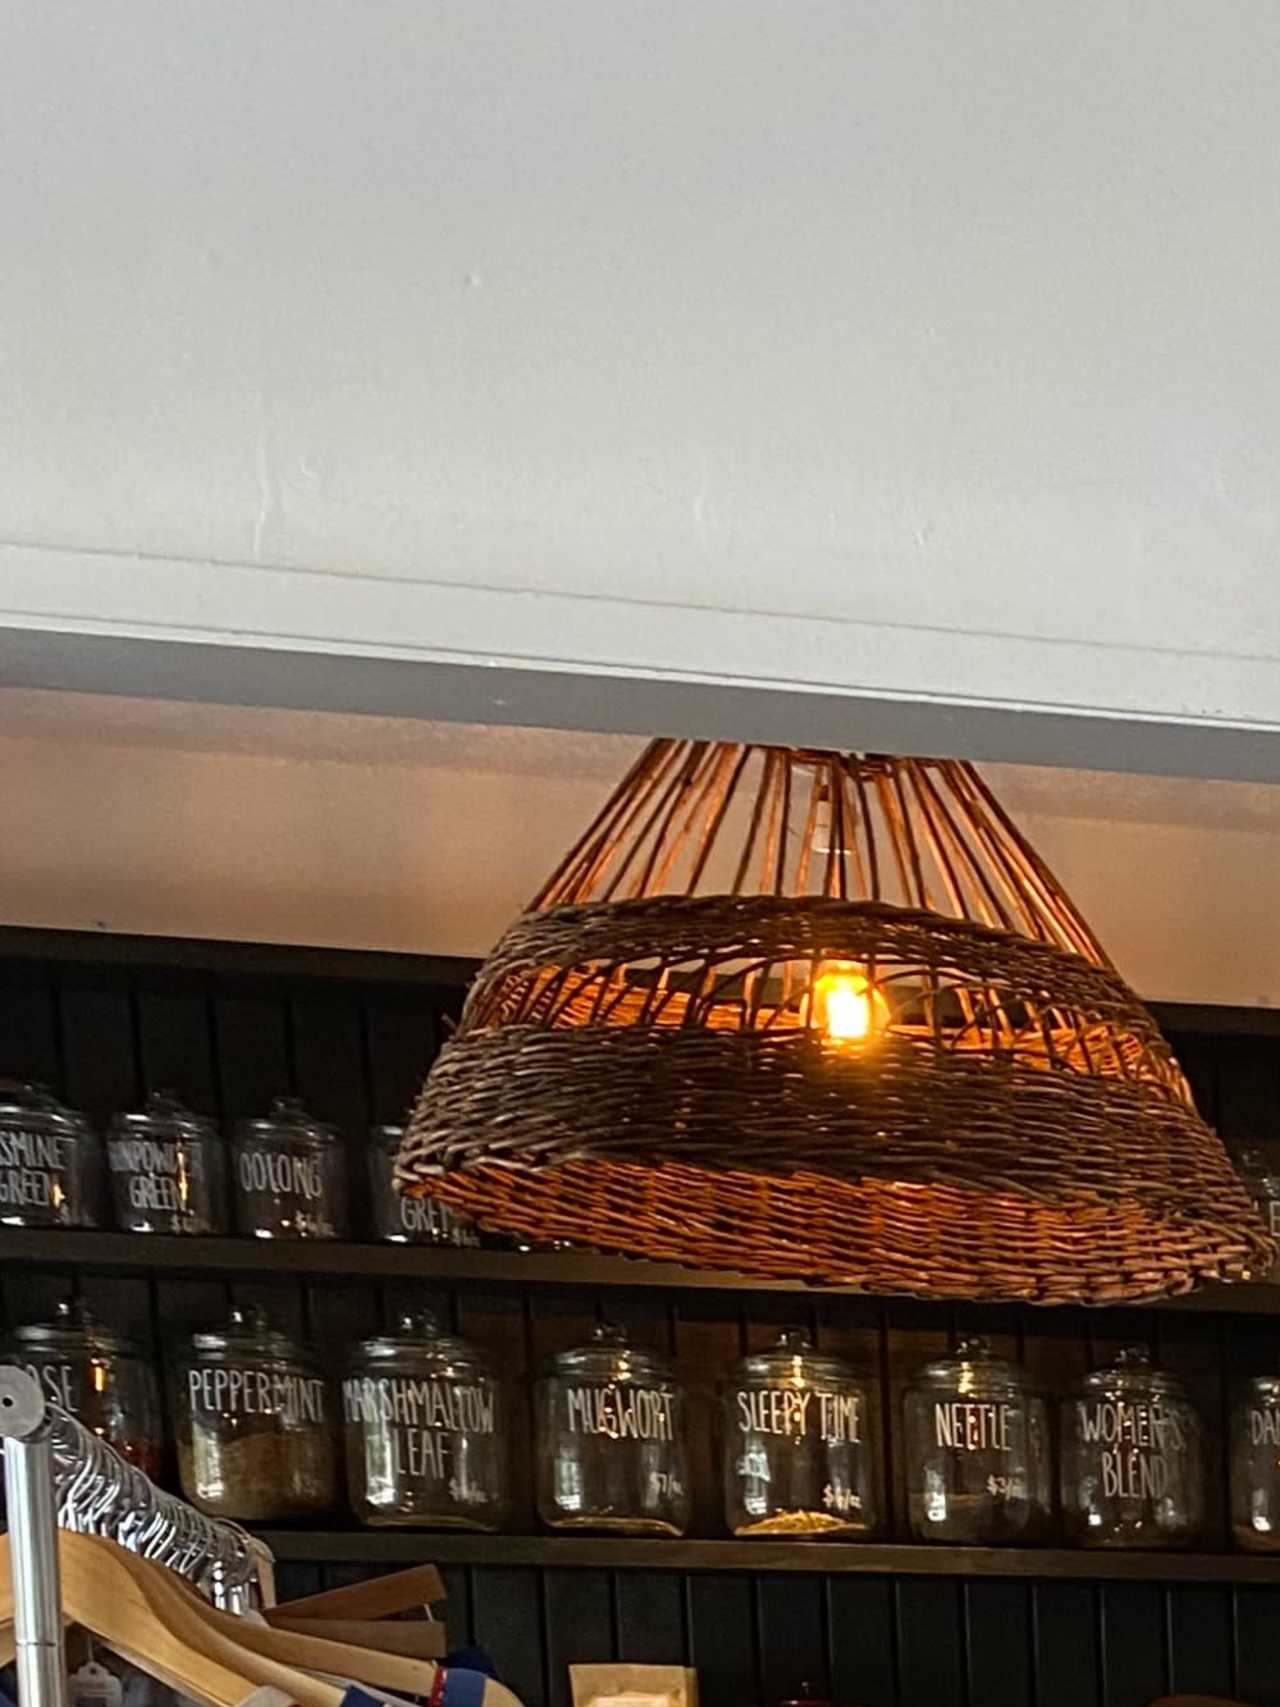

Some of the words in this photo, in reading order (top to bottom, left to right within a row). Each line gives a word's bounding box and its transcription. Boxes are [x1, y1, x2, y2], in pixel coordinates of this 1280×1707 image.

[238, 1151, 323, 1200] OOLONG
[25, 1364, 79, 1413] OSE
[187, 1368, 325, 1424] PEPPERMINT
[567, 1387, 676, 1441] MUGWORT
[736, 1389, 813, 1437] SLEEPY
[815, 1391, 863, 1444] TIME
[934, 1401, 1012, 1451] NETTLE
[393, 1430, 450, 1480] LEAF
[1101, 1450, 1171, 1500] BLEND
